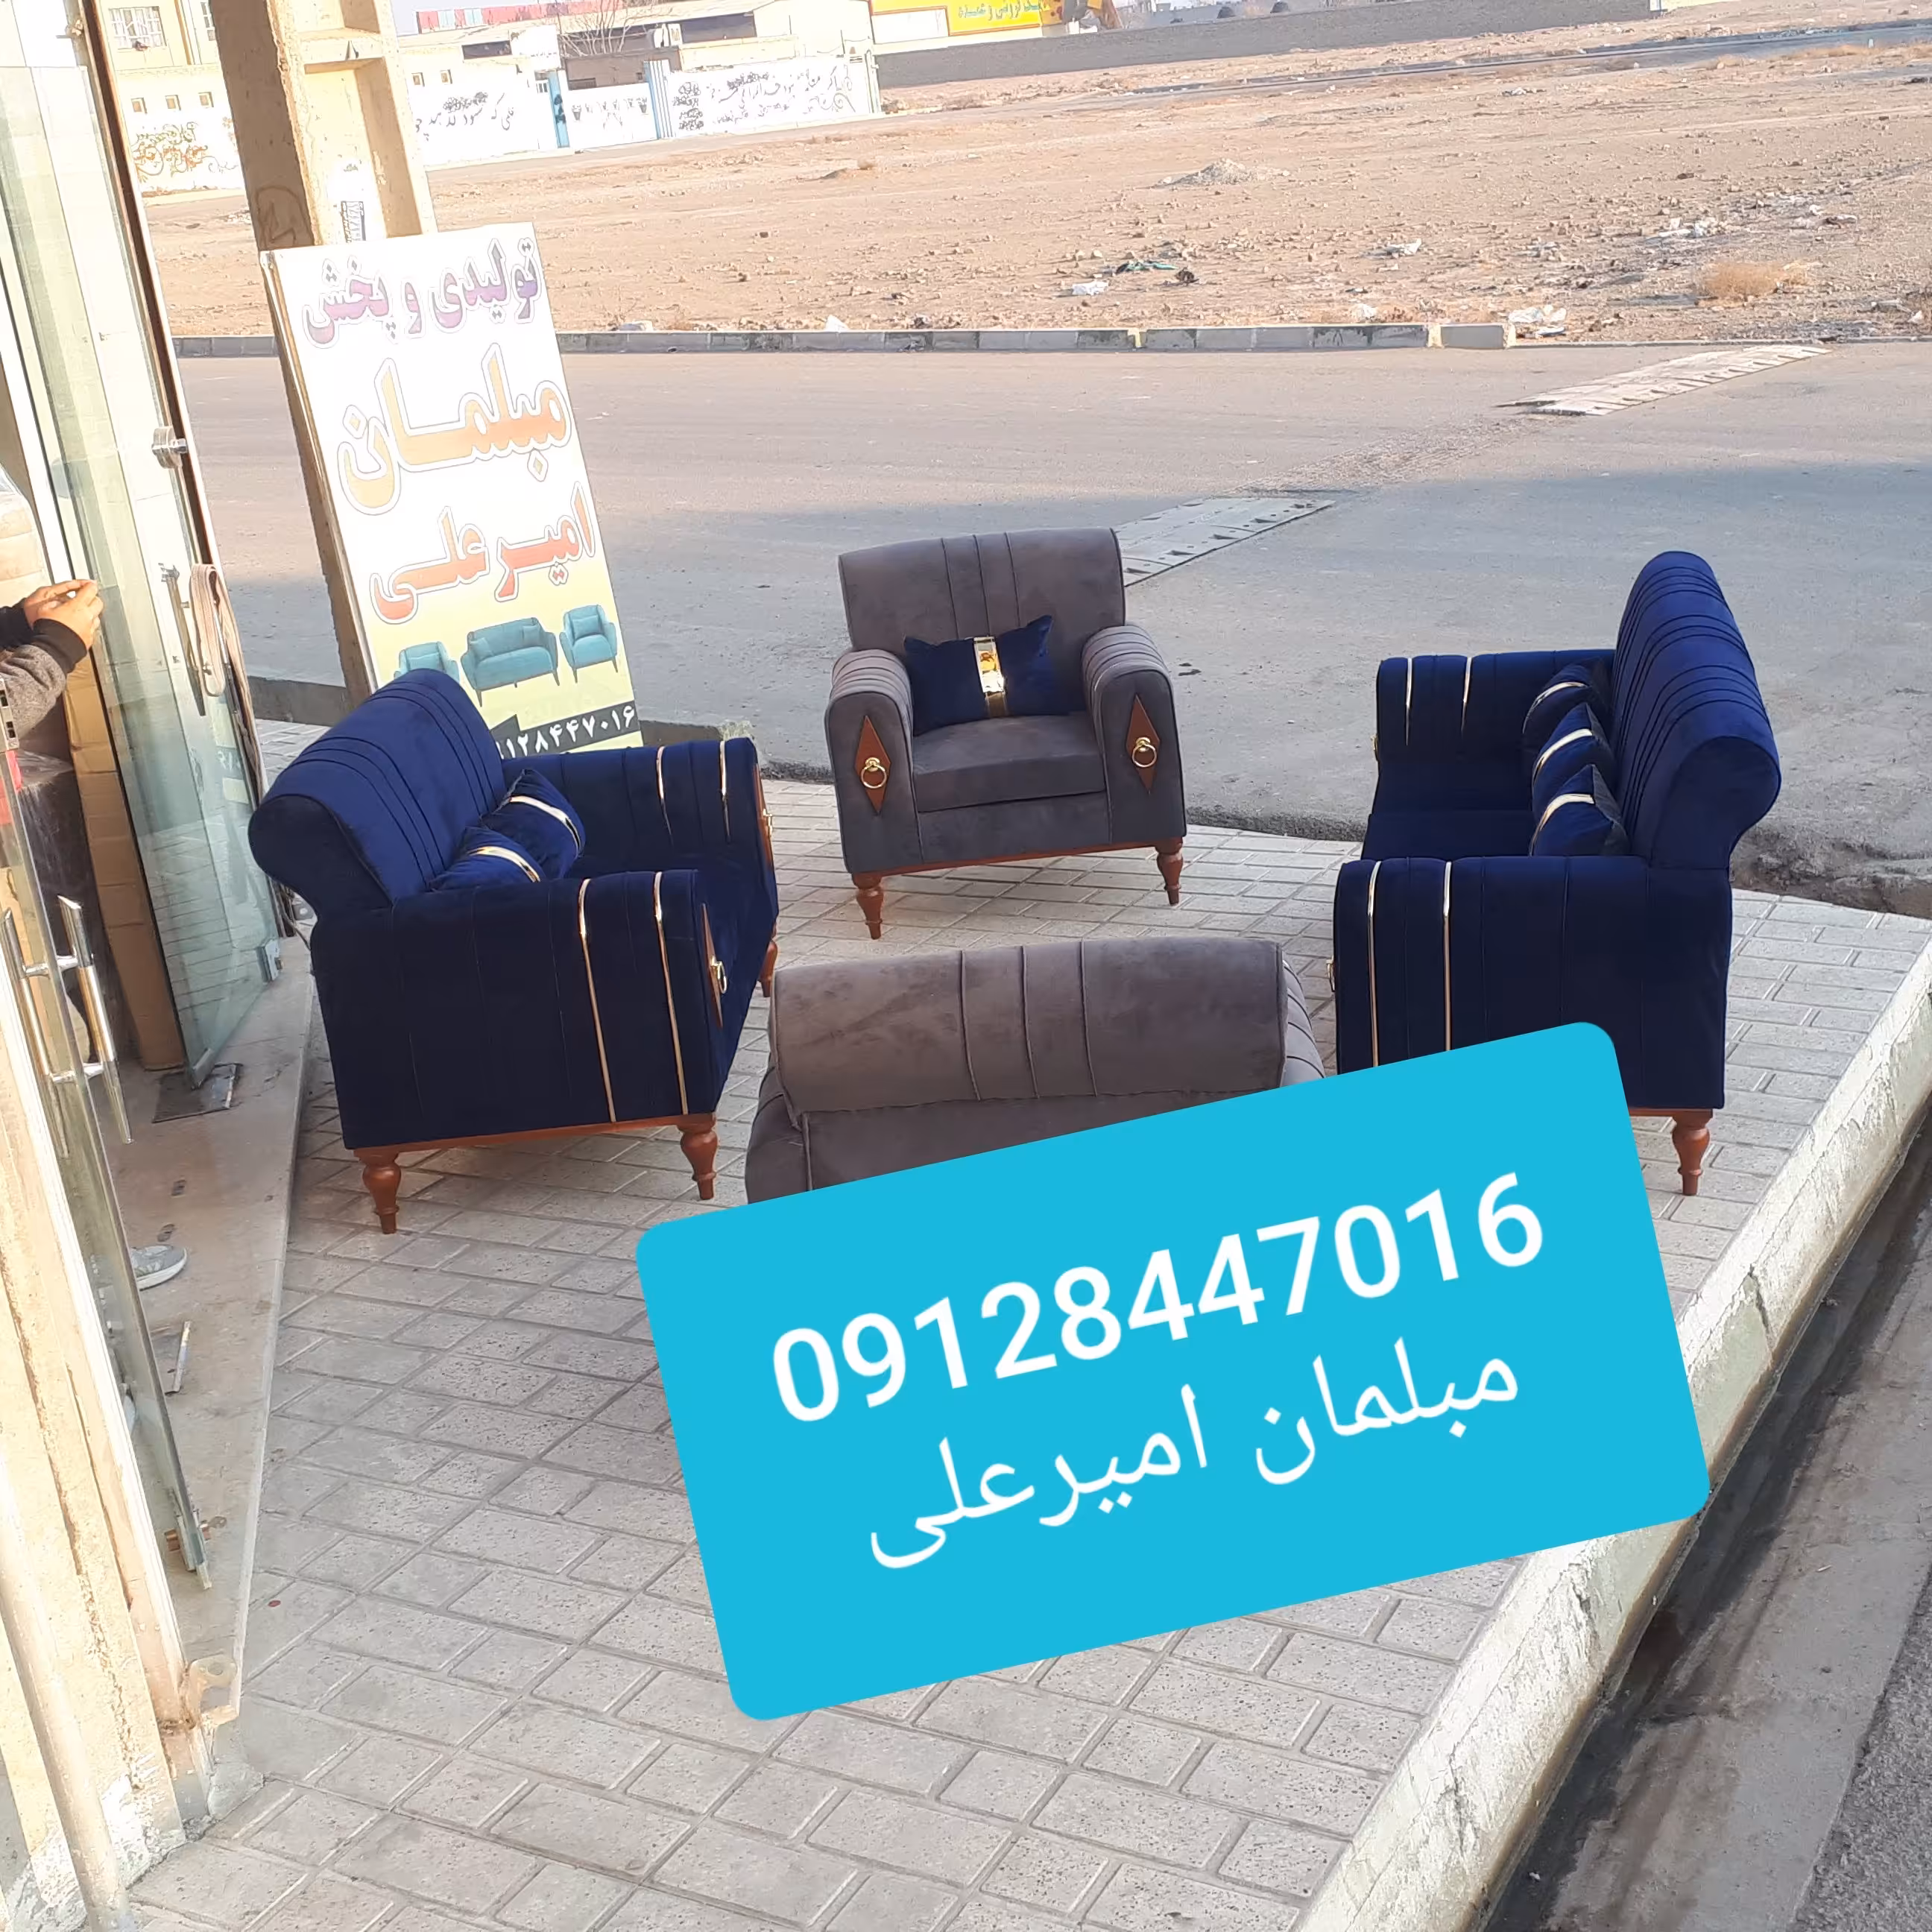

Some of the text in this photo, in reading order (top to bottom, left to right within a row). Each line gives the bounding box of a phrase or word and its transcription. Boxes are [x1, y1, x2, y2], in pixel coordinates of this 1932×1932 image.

[301, 236, 544, 349] تولیدی و پخش
[337, 342, 572, 515] مبلمان
